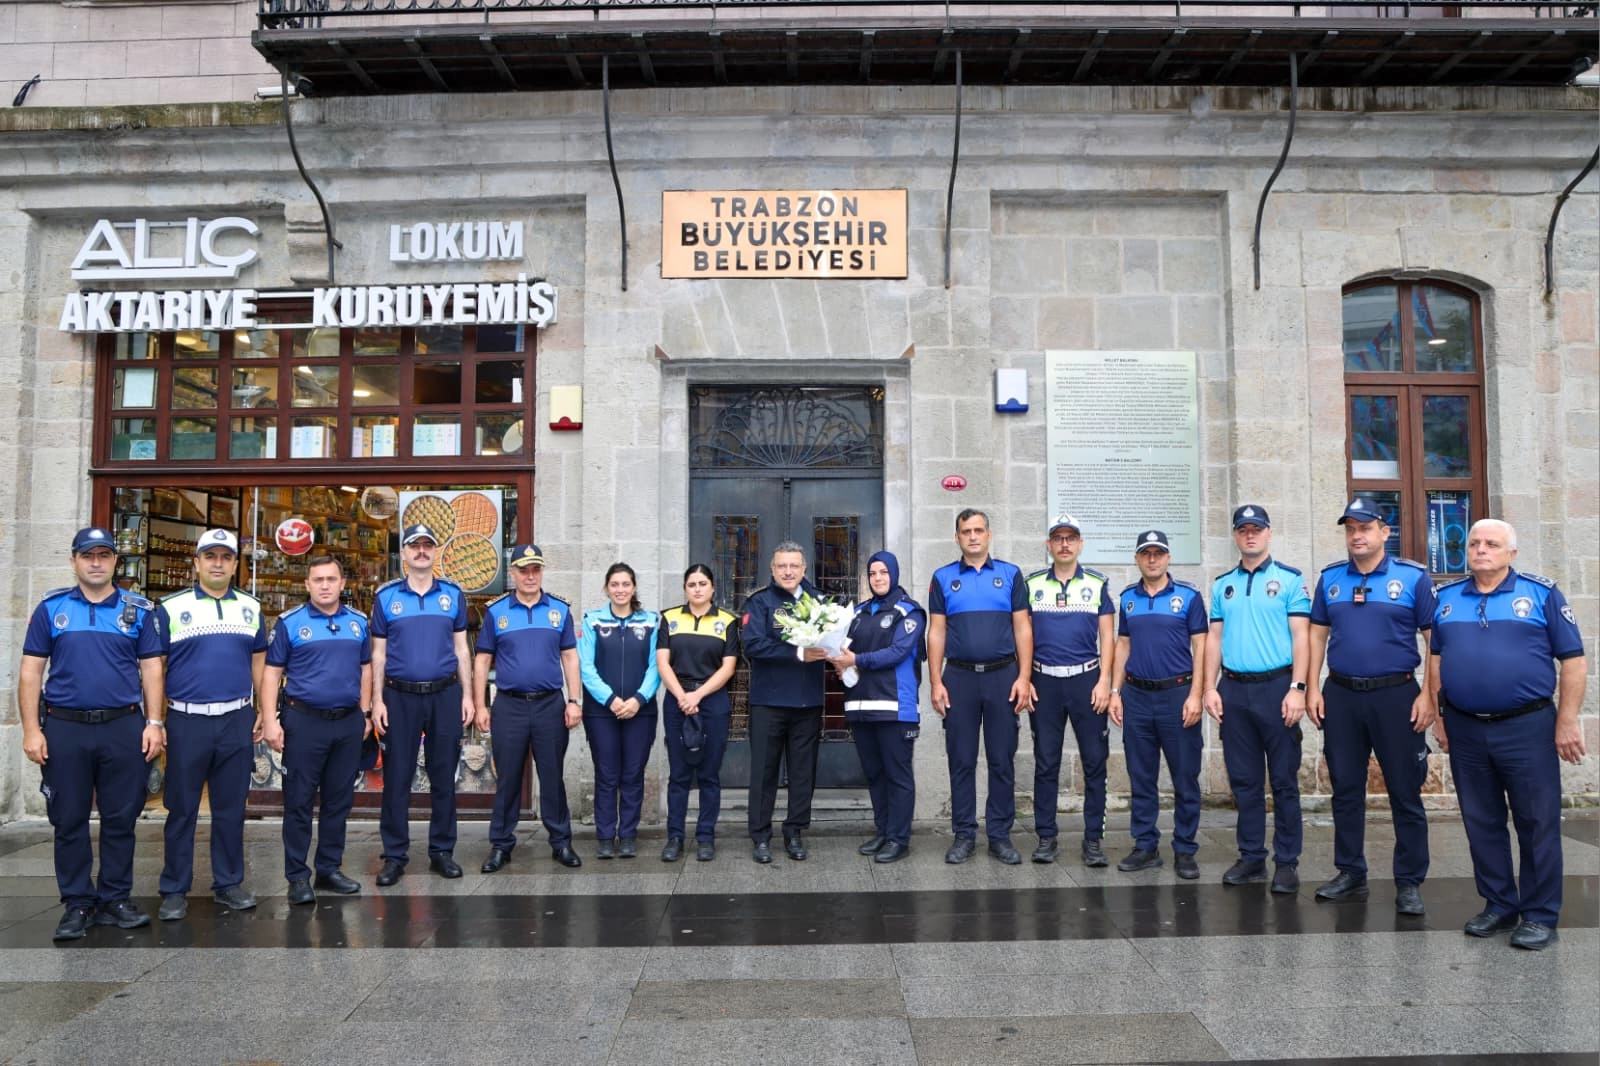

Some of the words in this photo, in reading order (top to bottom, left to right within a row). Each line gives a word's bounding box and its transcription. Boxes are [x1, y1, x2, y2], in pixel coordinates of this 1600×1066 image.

[711, 197, 858, 217] TRABZON
[390, 221, 524, 260] LOKUM
[681, 221, 887, 247] BÜYÜKŞEHİR
[694, 250, 876, 271] BELEDİYESİ
[60, 289, 257, 331] AKTARIYE
[312, 273, 557, 328] KURUYEMİŞ
